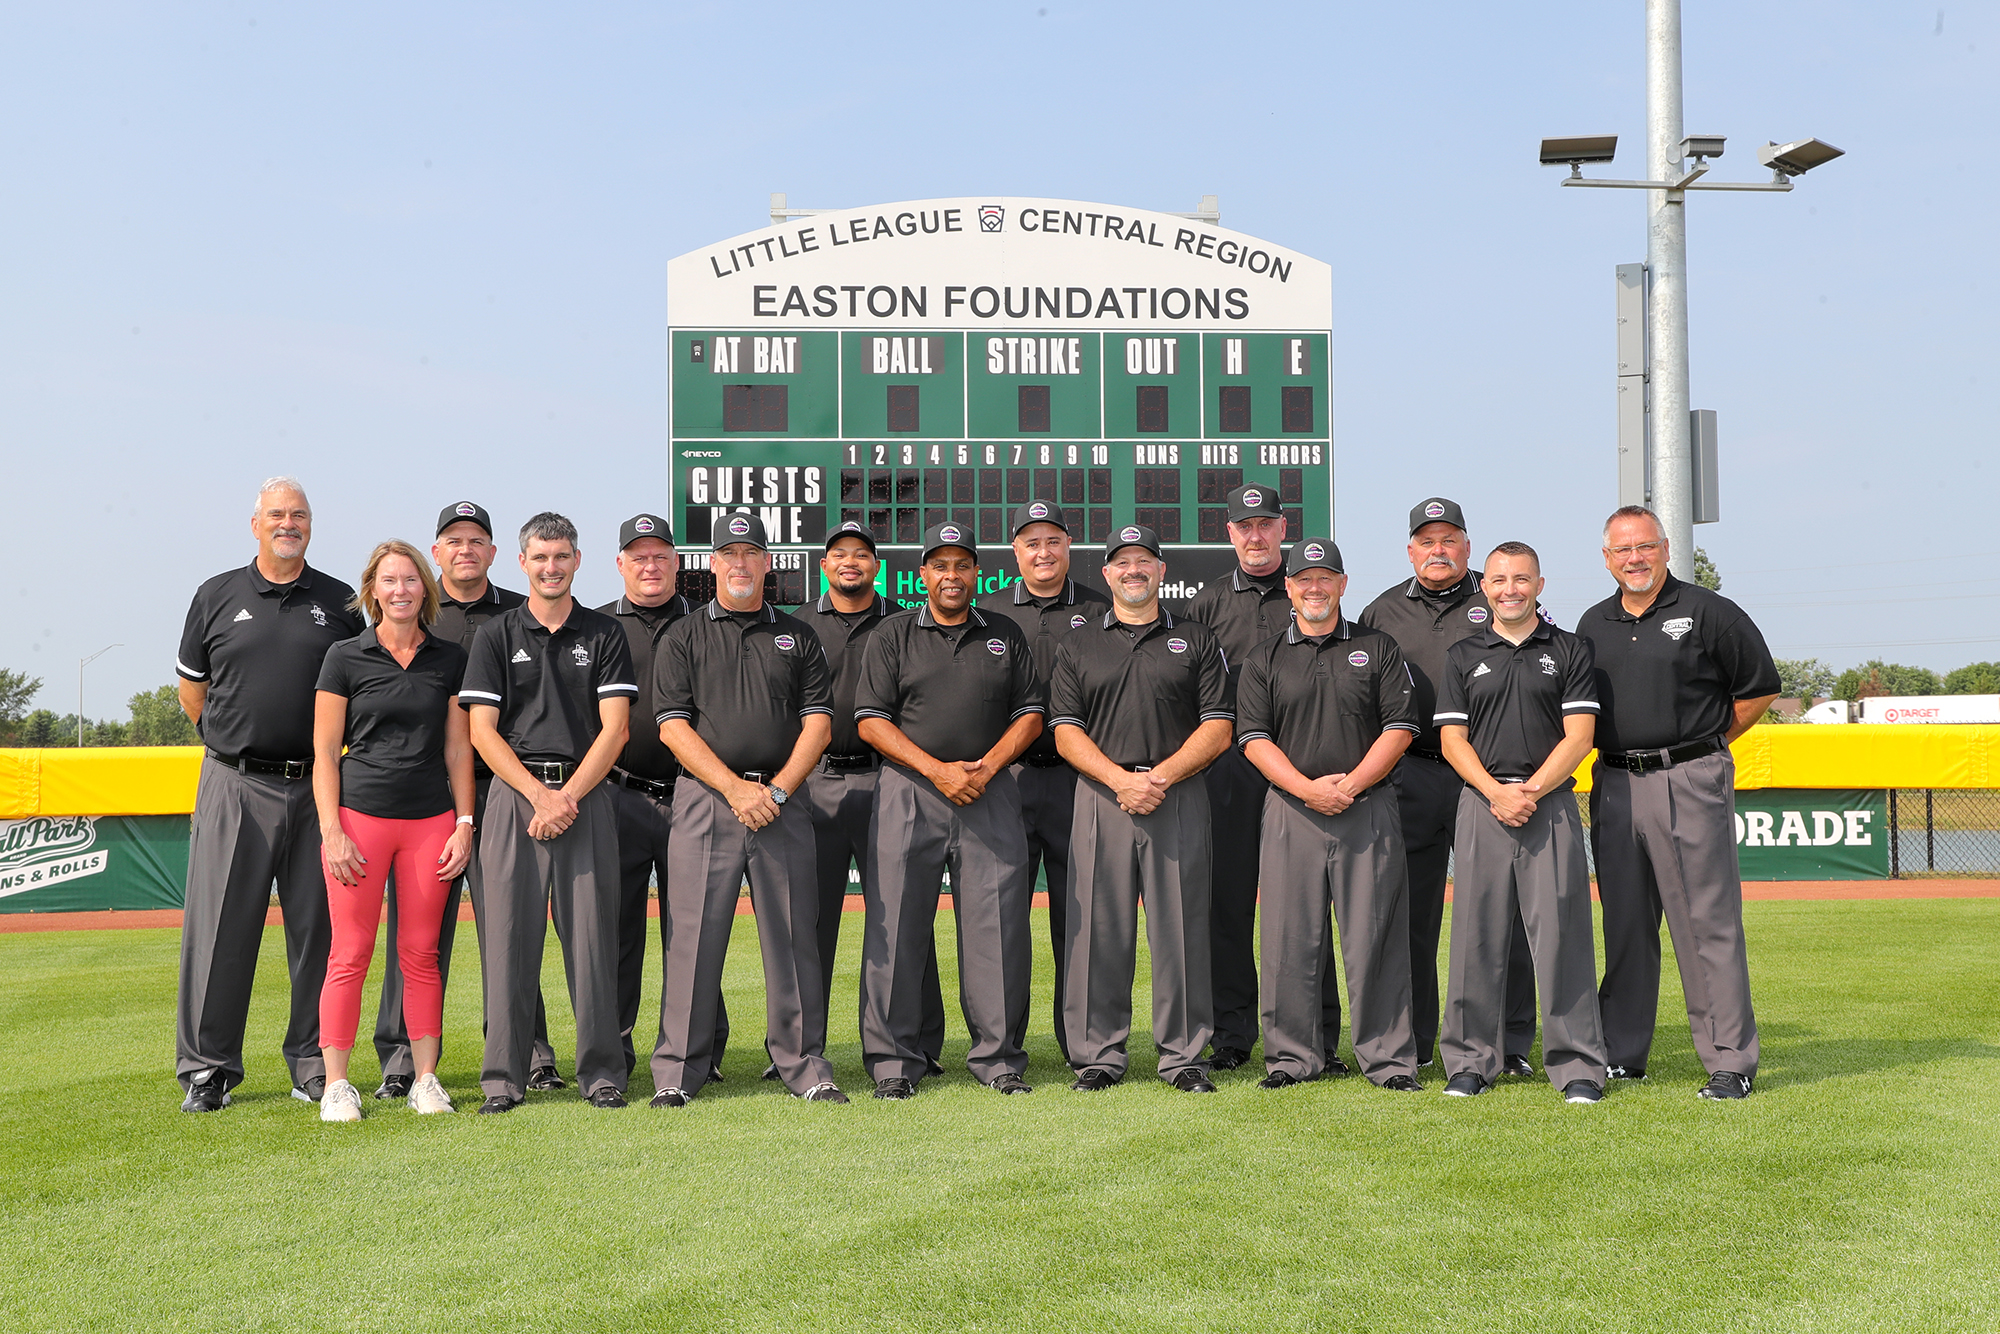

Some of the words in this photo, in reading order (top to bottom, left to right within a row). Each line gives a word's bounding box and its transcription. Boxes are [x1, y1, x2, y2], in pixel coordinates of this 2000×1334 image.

[709, 227, 820, 279] LITTLE
[828, 208, 963, 248] LEAGUE
[1019, 207, 1165, 248] CENTRAL
[1173, 228, 1293, 283] REGION
[753, 285, 927, 318] EASTON
[945, 286, 1250, 320] FOUNDATIONS
[713, 336, 741, 374] AT
[753, 336, 797, 374] BAT
[872, 337, 933, 374] BALL
[987, 337, 1080, 375] STRIKE
[1126, 338, 1177, 375] OUT
[1226, 338, 1243, 375] H
[1290, 339, 1303, 375] E
[848, 444, 856, 465] 1
[875, 444, 884, 465] 2
[902, 444, 912, 465] 3
[930, 444, 940, 465] 4
[957, 444, 967, 465] 5
[985, 444, 994, 465] 6
[1013, 444, 1021, 465] 7
[1040, 444, 1049, 465] 8
[1067, 444, 1077, 465] 9
[1091, 444, 1108, 465] 10
[1136, 444, 1178, 465] RUNS
[1202, 444, 1238, 465] HITS
[1260, 445, 1321, 465] ERRORS
[692, 466, 820, 504] GUESTS
[1899, 708, 1940, 718] TARGET
[30, 870, 43, 882] &
[48, 856, 100, 878] ROLLS
